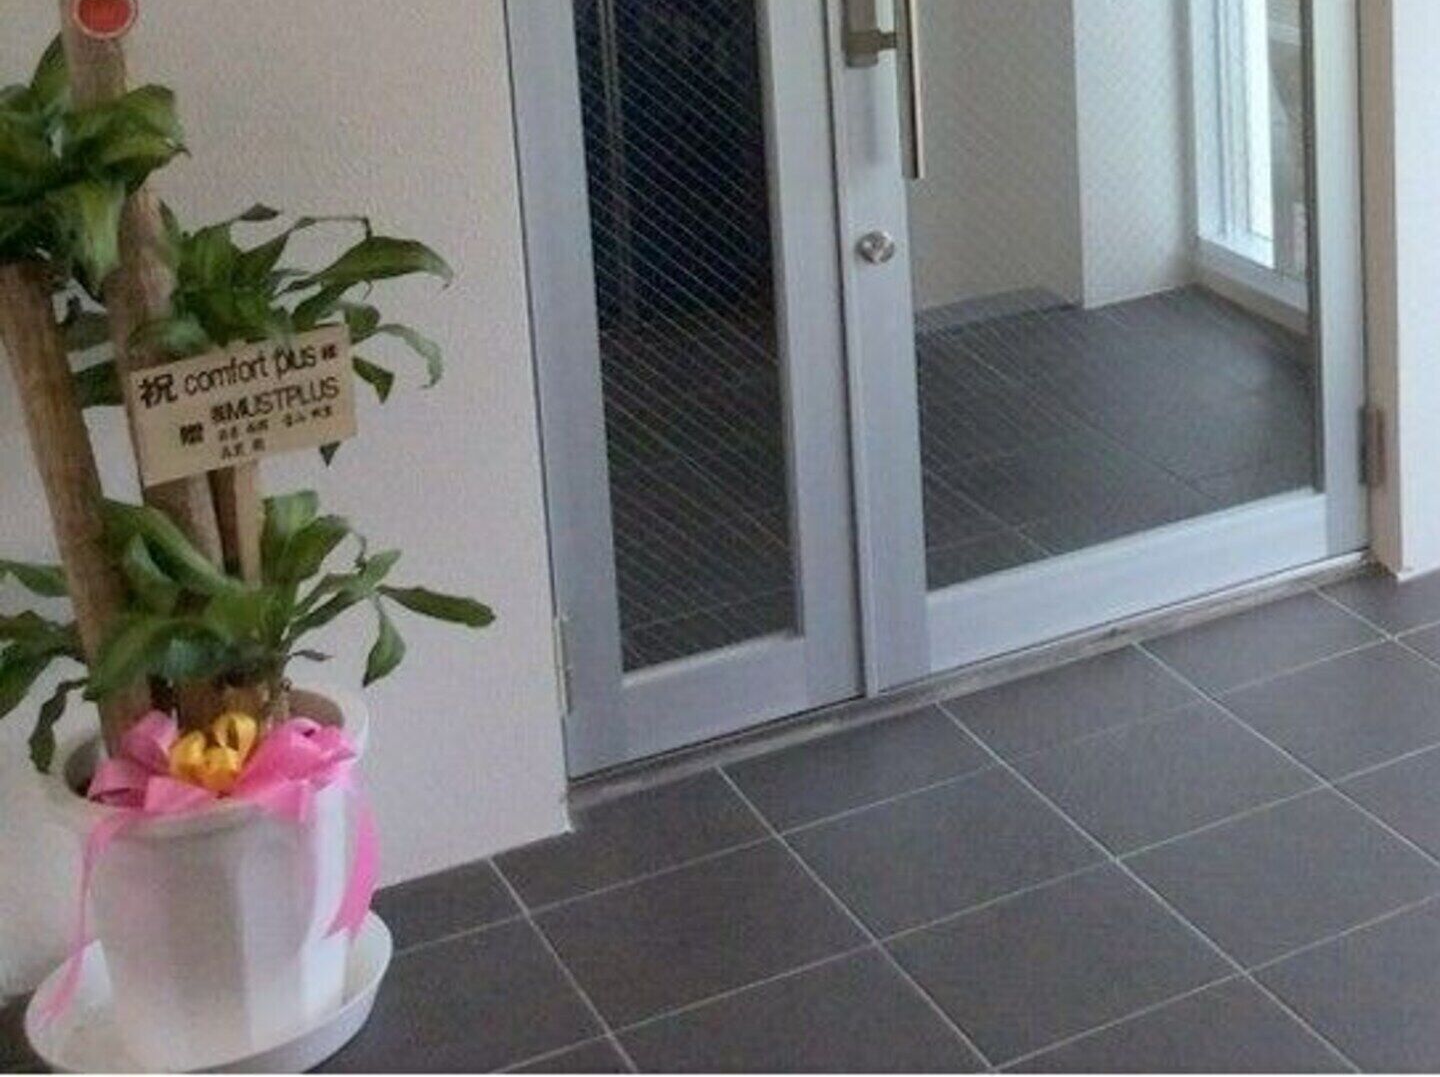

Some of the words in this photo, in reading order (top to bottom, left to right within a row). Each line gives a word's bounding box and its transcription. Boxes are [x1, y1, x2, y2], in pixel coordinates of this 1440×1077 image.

[138, 373, 178, 409] 祝
[184, 351, 268, 396] comfort
[275, 345, 317, 379] plus
